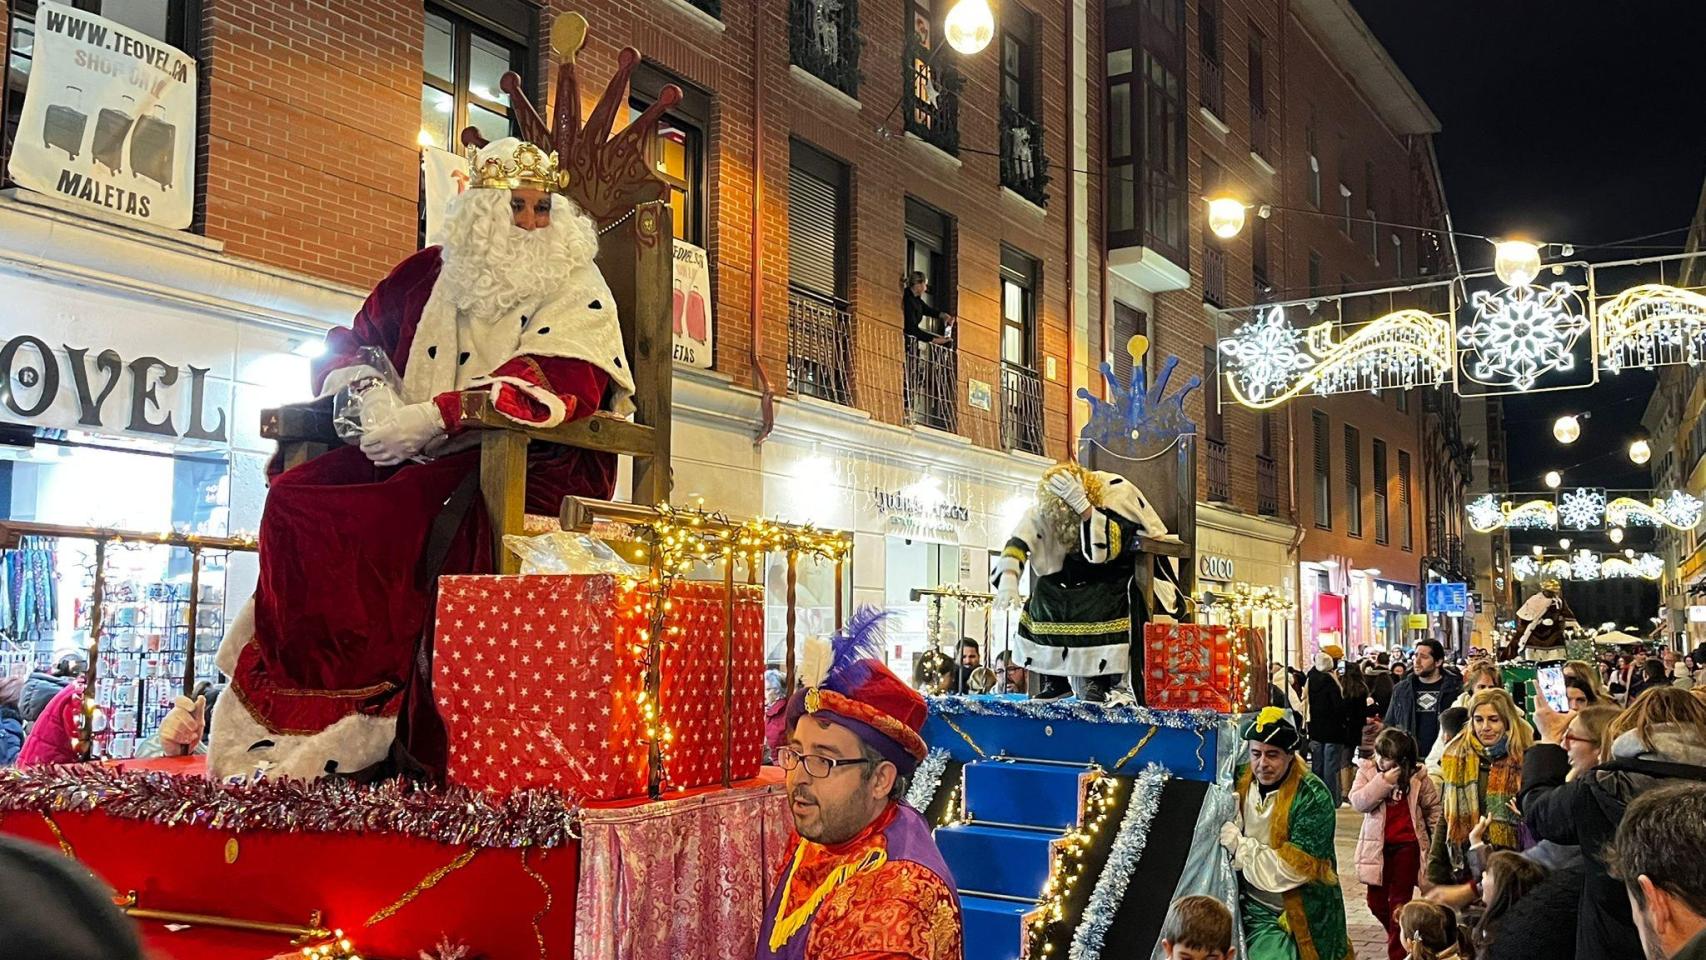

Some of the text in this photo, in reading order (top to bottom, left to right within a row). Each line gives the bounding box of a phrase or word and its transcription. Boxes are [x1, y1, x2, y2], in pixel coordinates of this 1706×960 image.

[56, 169, 151, 218] MALETAS
[673, 344, 695, 363] ETAS
[0, 335, 228, 442] OVEL
[1200, 555, 1233, 580] COCO
